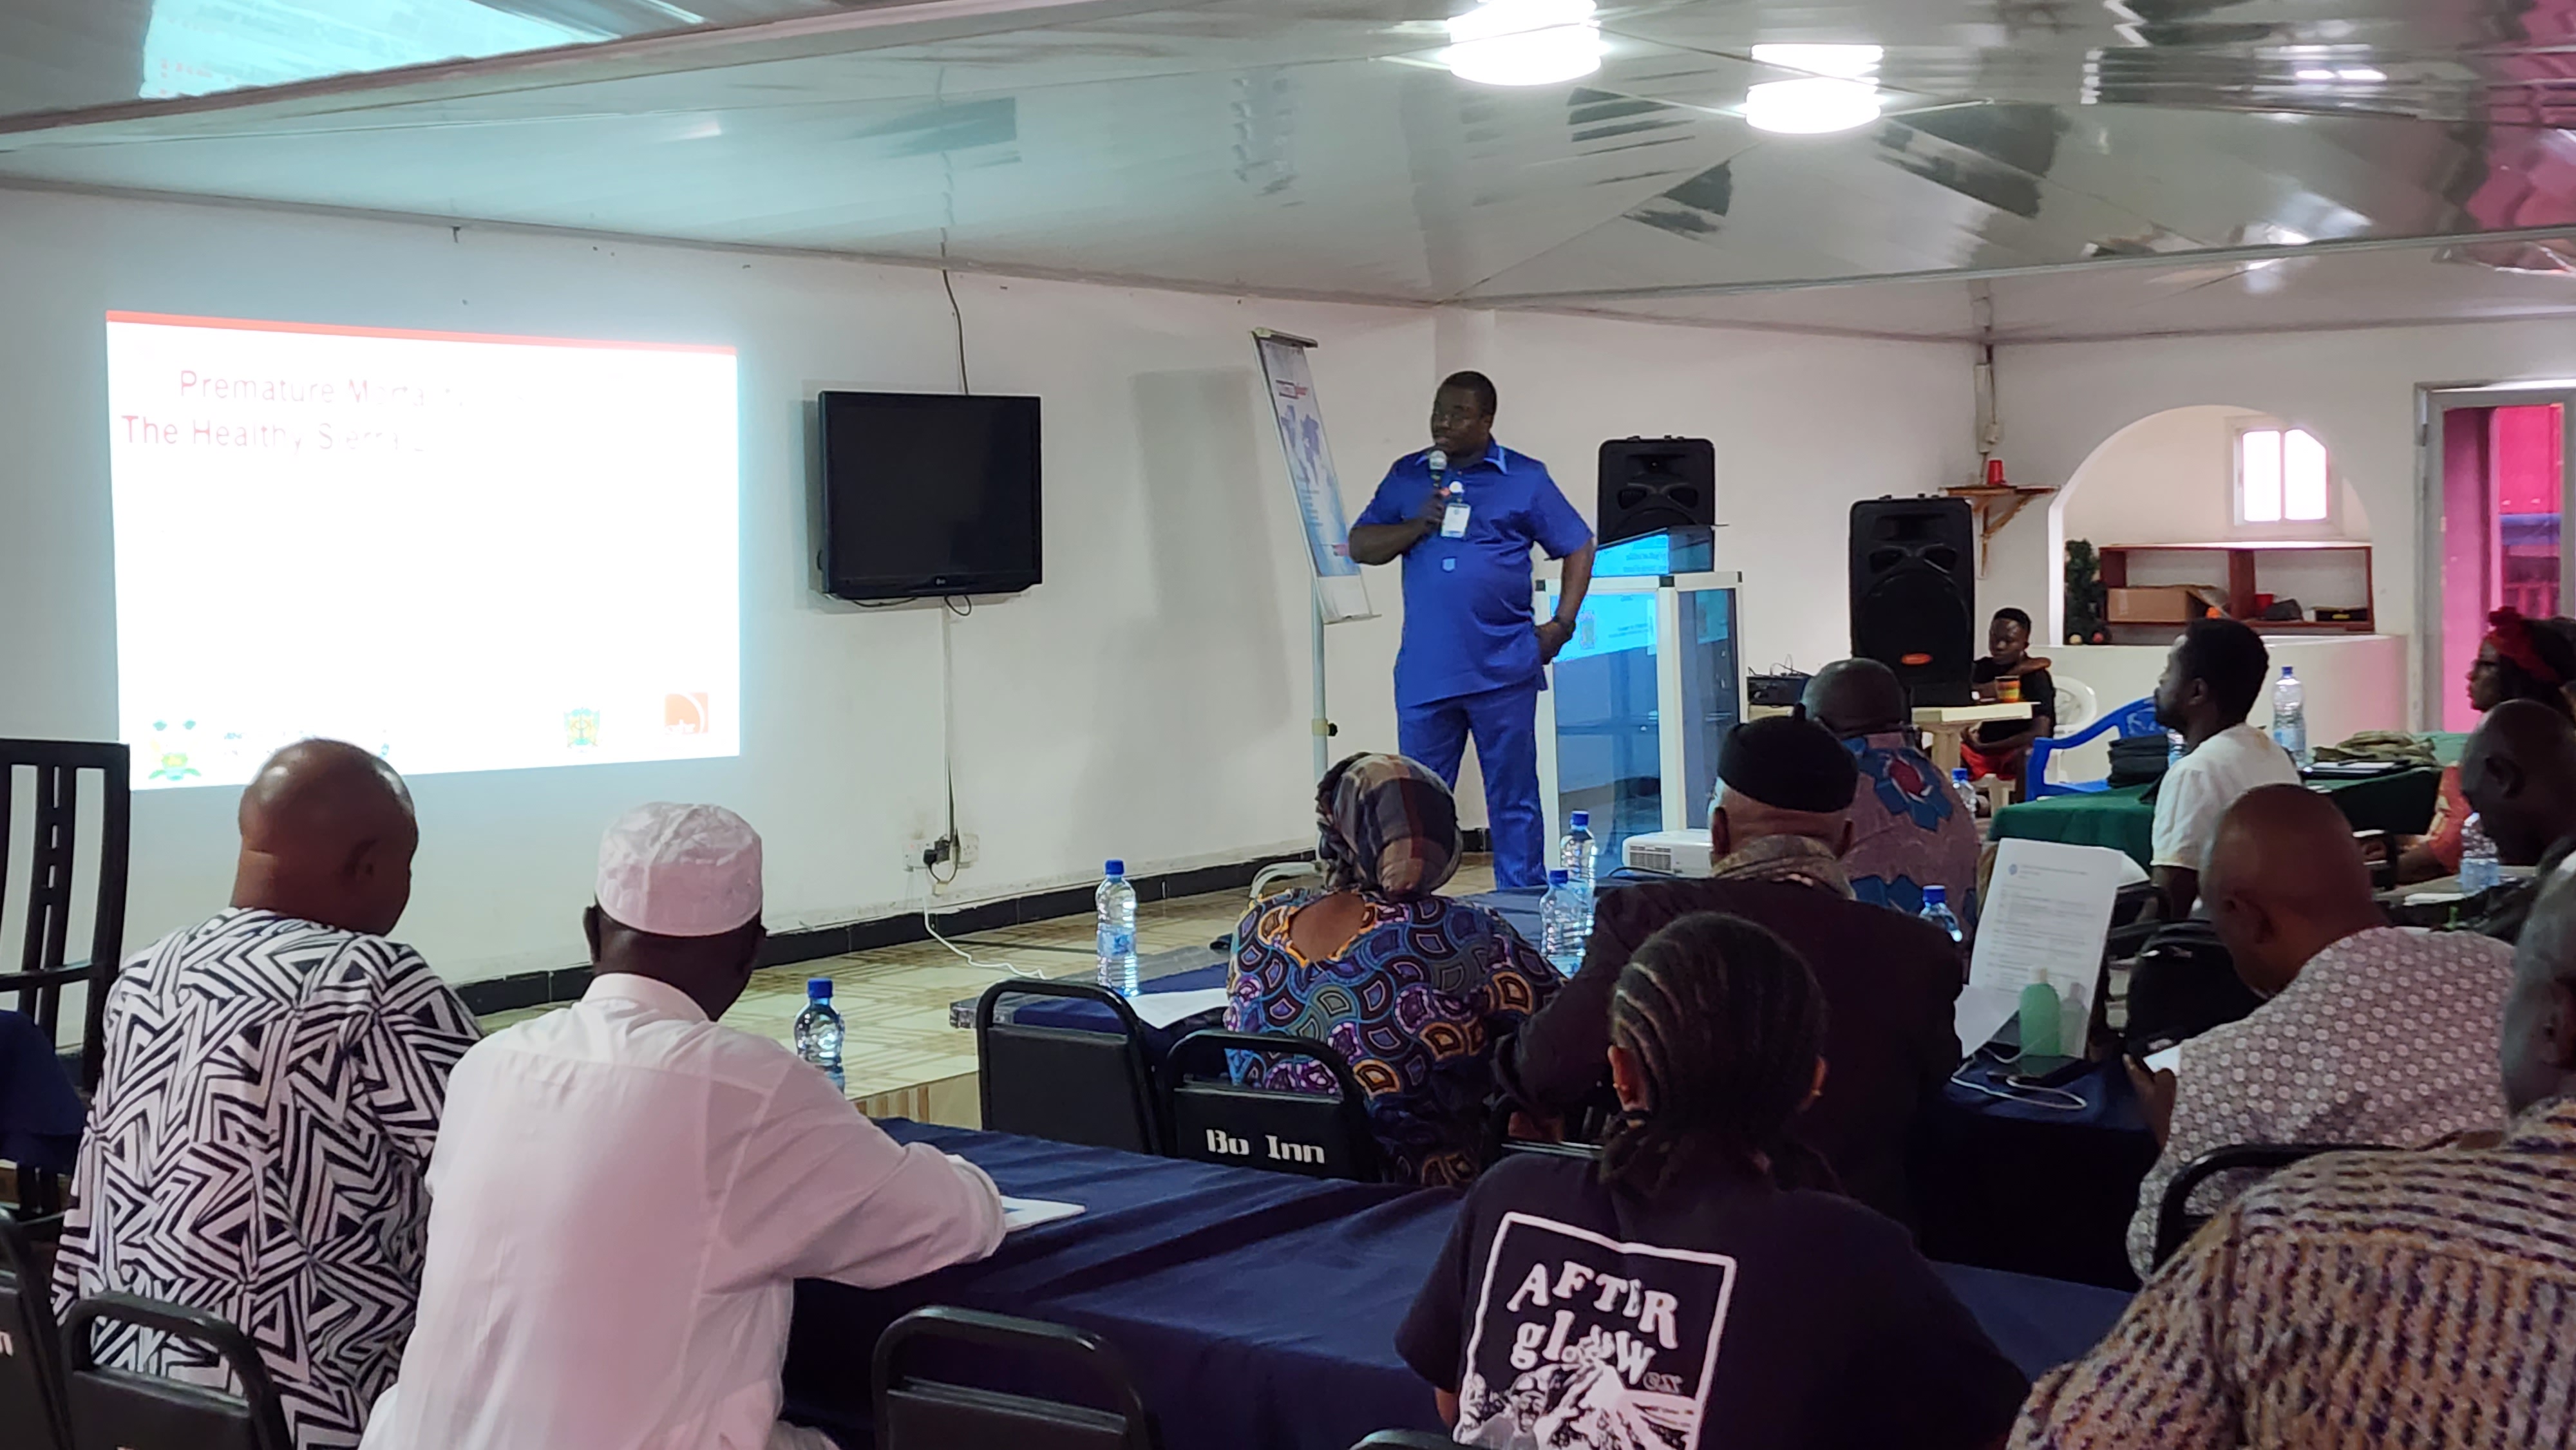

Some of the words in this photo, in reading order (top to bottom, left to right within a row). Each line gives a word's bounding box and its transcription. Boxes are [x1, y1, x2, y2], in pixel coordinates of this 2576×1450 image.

[180, 369, 334, 404] Premature
[120, 414, 178, 445] The
[192, 419, 302, 457] Healthy
[1265, 1134, 1325, 1164] Inn
